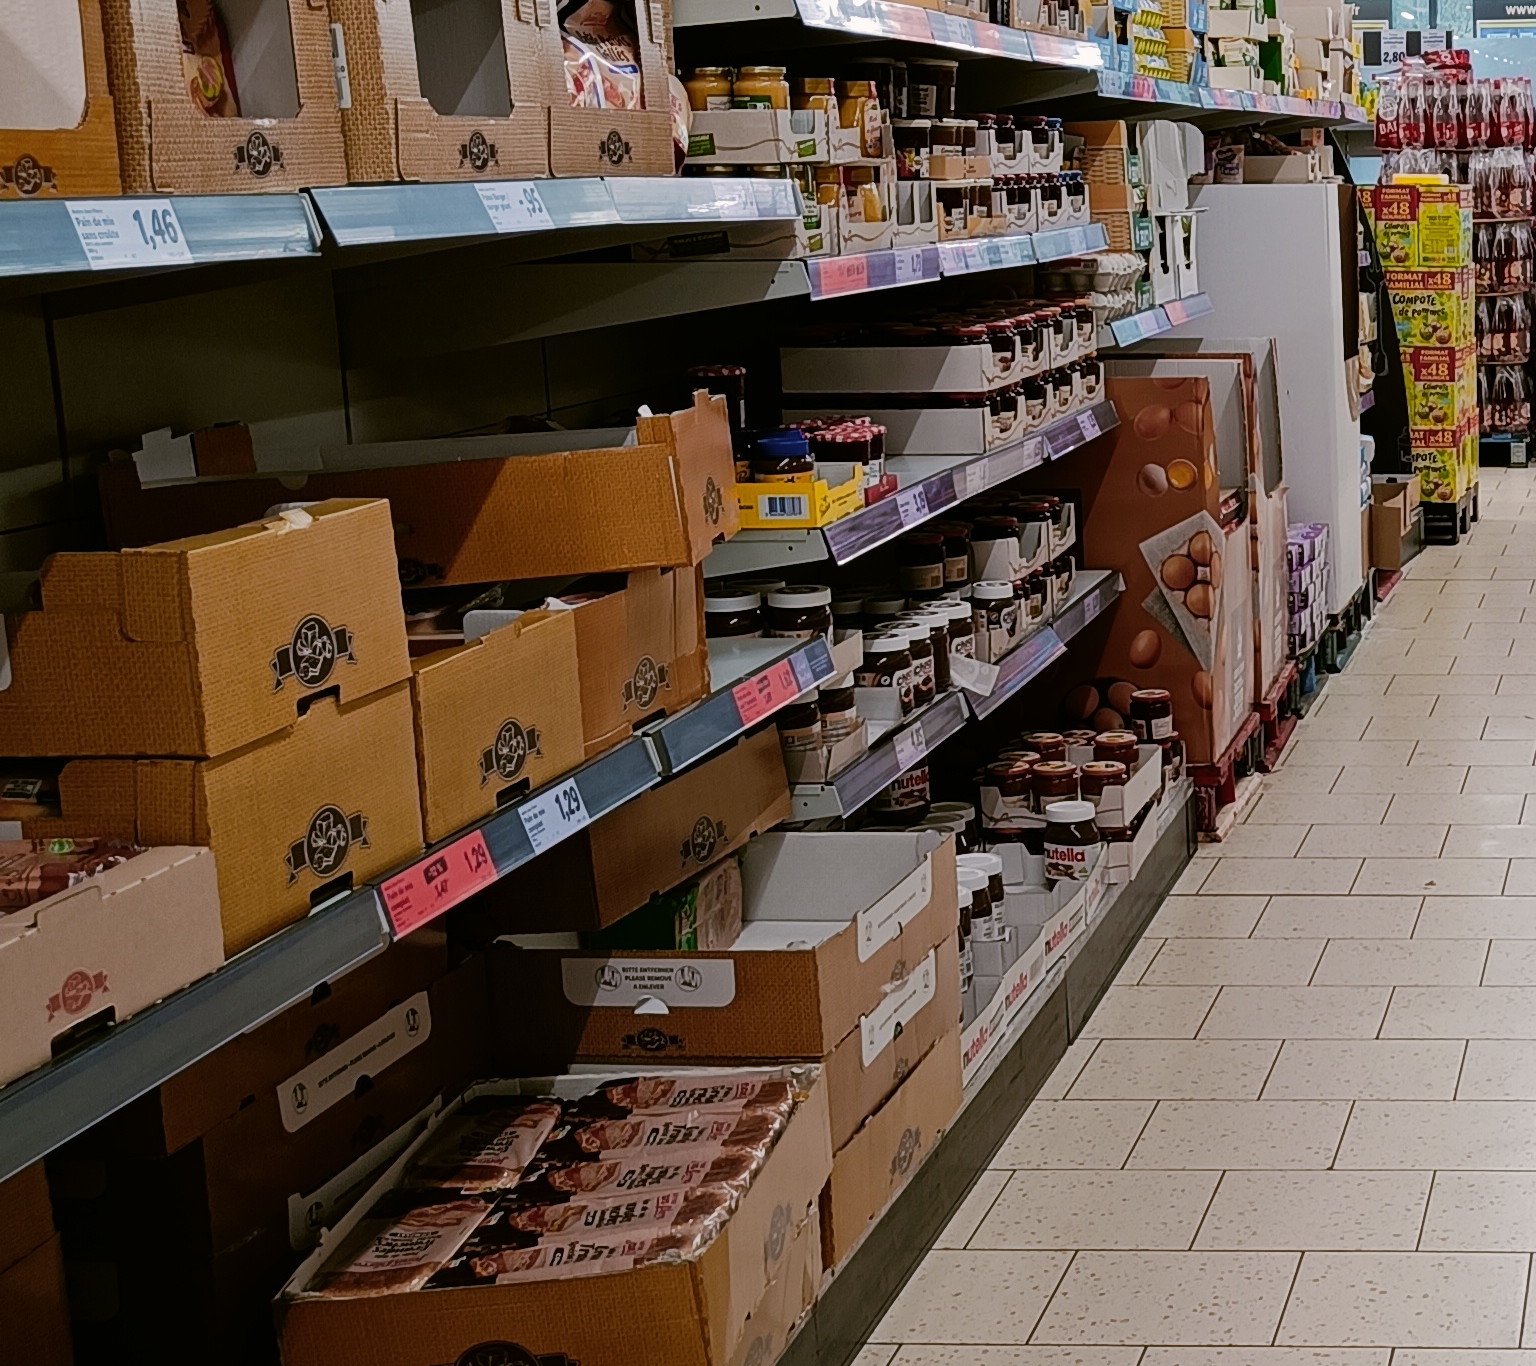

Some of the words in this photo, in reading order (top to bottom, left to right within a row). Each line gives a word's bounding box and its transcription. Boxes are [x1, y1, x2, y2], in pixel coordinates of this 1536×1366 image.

[519, 188, 543, 218] -,95
[1382, 202, 1411, 215] x48
[74, 215, 91, 228] Pain
[92, 216, 102, 227] de
[103, 216, 116, 227] mie
[132, 206, 178, 251] 1,46
[81, 231, 96, 240] sans
[1385, 272, 1422, 281] FORMAT
[1427, 273, 1451, 285] x48
[1392, 293, 1437, 306] COMPOTE
[1398, 307, 1410, 316] de
[1411, 307, 1445, 317] pommes
[1420, 363, 1450, 376] x48
[554, 786, 581, 822] 1,29
[463, 842, 488, 874] 1,29
